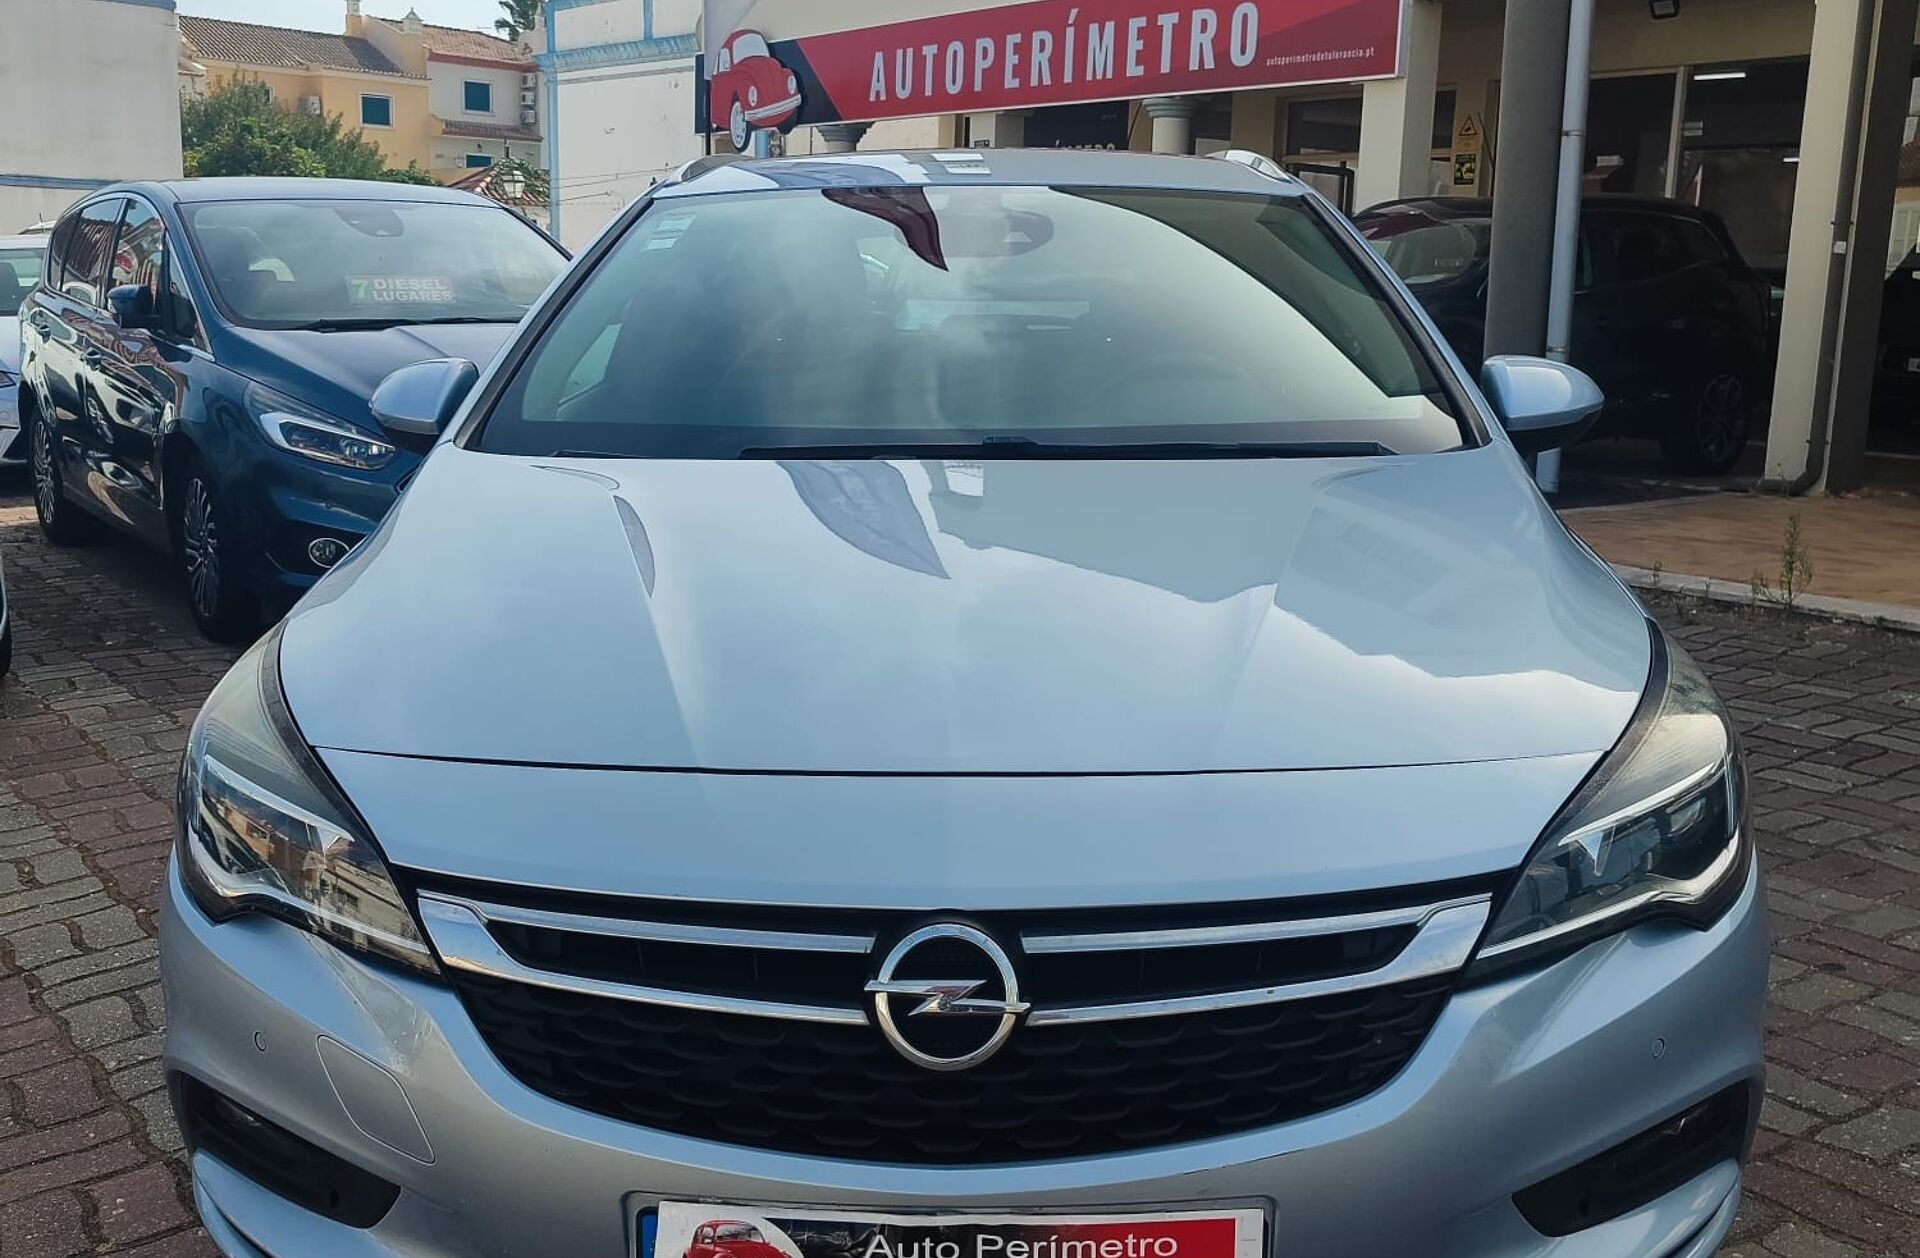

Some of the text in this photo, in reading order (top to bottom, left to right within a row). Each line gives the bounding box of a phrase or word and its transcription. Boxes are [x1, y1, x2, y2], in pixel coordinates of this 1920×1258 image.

[868, 1, 1260, 102] AUTOPERÍMETRO
[351, 280, 368, 300] 7
[373, 278, 448, 290] DIESEL
[372, 289, 454, 301] LUGARES
[863, 1233, 1178, 1258] Auto Perímetro
